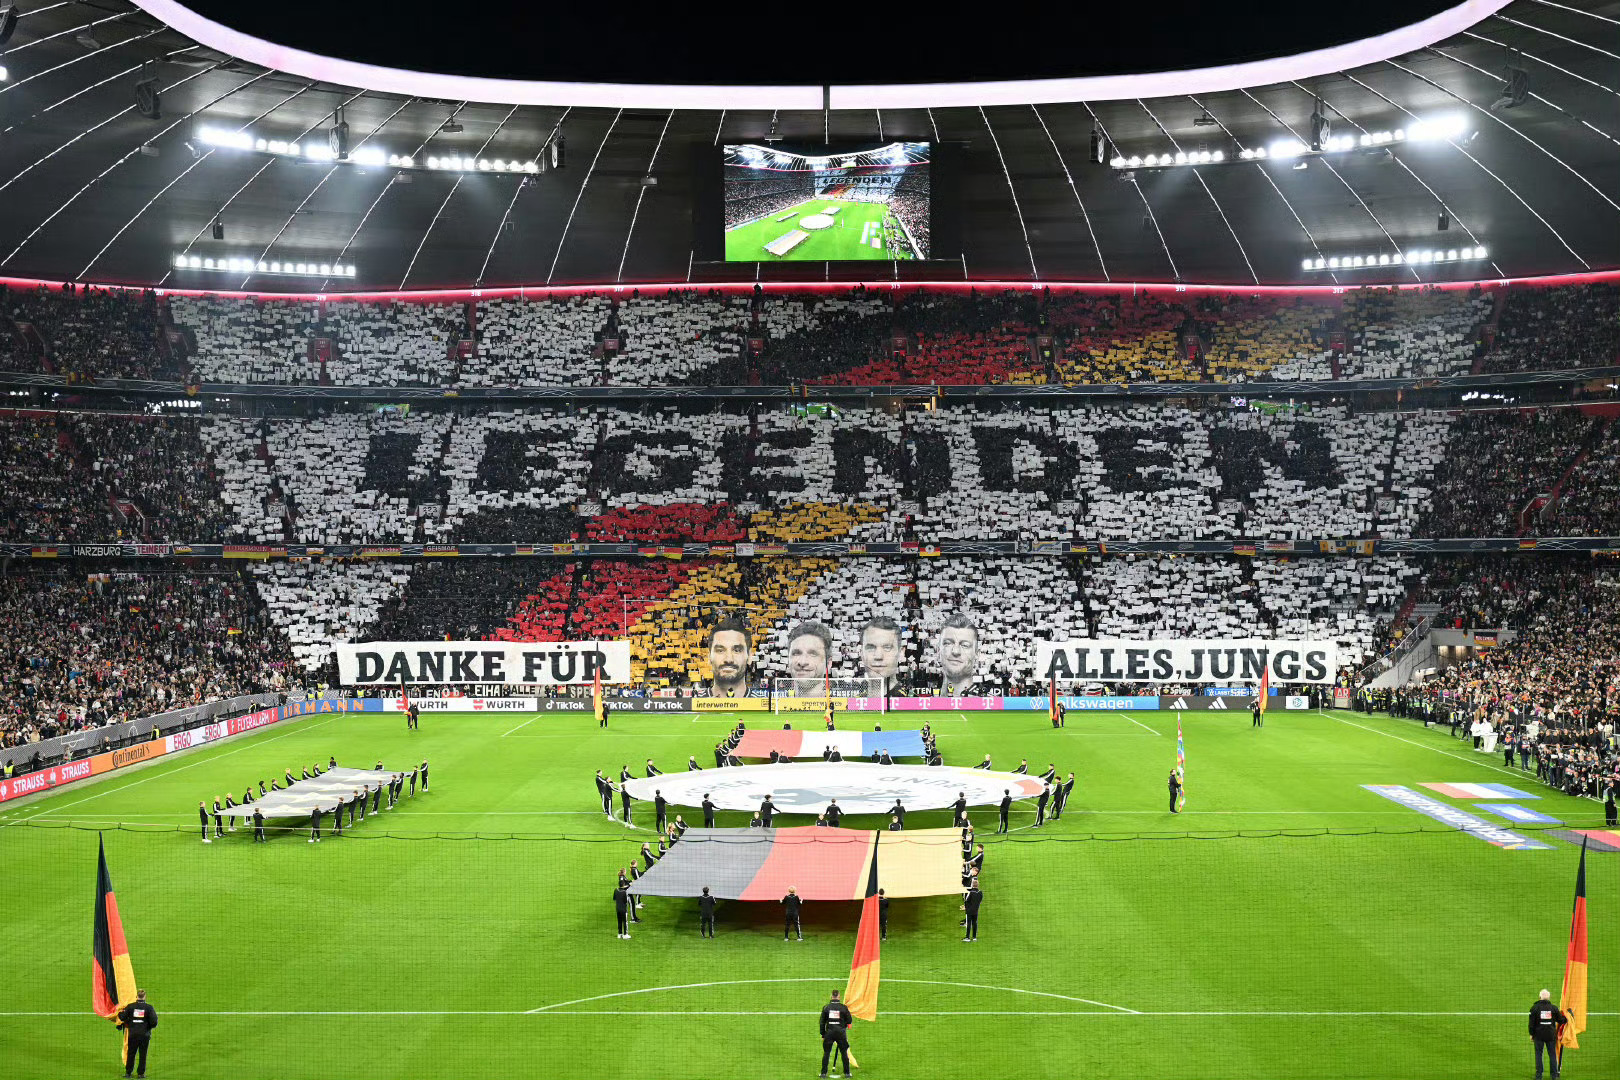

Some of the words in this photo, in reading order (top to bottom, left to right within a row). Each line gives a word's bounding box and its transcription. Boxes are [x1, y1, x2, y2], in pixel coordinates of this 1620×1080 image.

[822, 175, 892, 185] LEGENDEN
[73, 546, 121, 556] HARZBURG
[136, 544, 169, 554] TEINERT
[355, 650, 506, 683] DANKE
[522, 644, 612, 682] FÜR
[556, 702, 585, 710] TikTok
[654, 701, 683, 710] TikTok
[237, 714, 271, 731] FLYERALARM
[173, 732, 192, 750] ERGO
[112, 744, 145, 768] Continental
[61, 761, 90, 780] STRAUSS
[13, 774, 45, 794] STRAUSS
